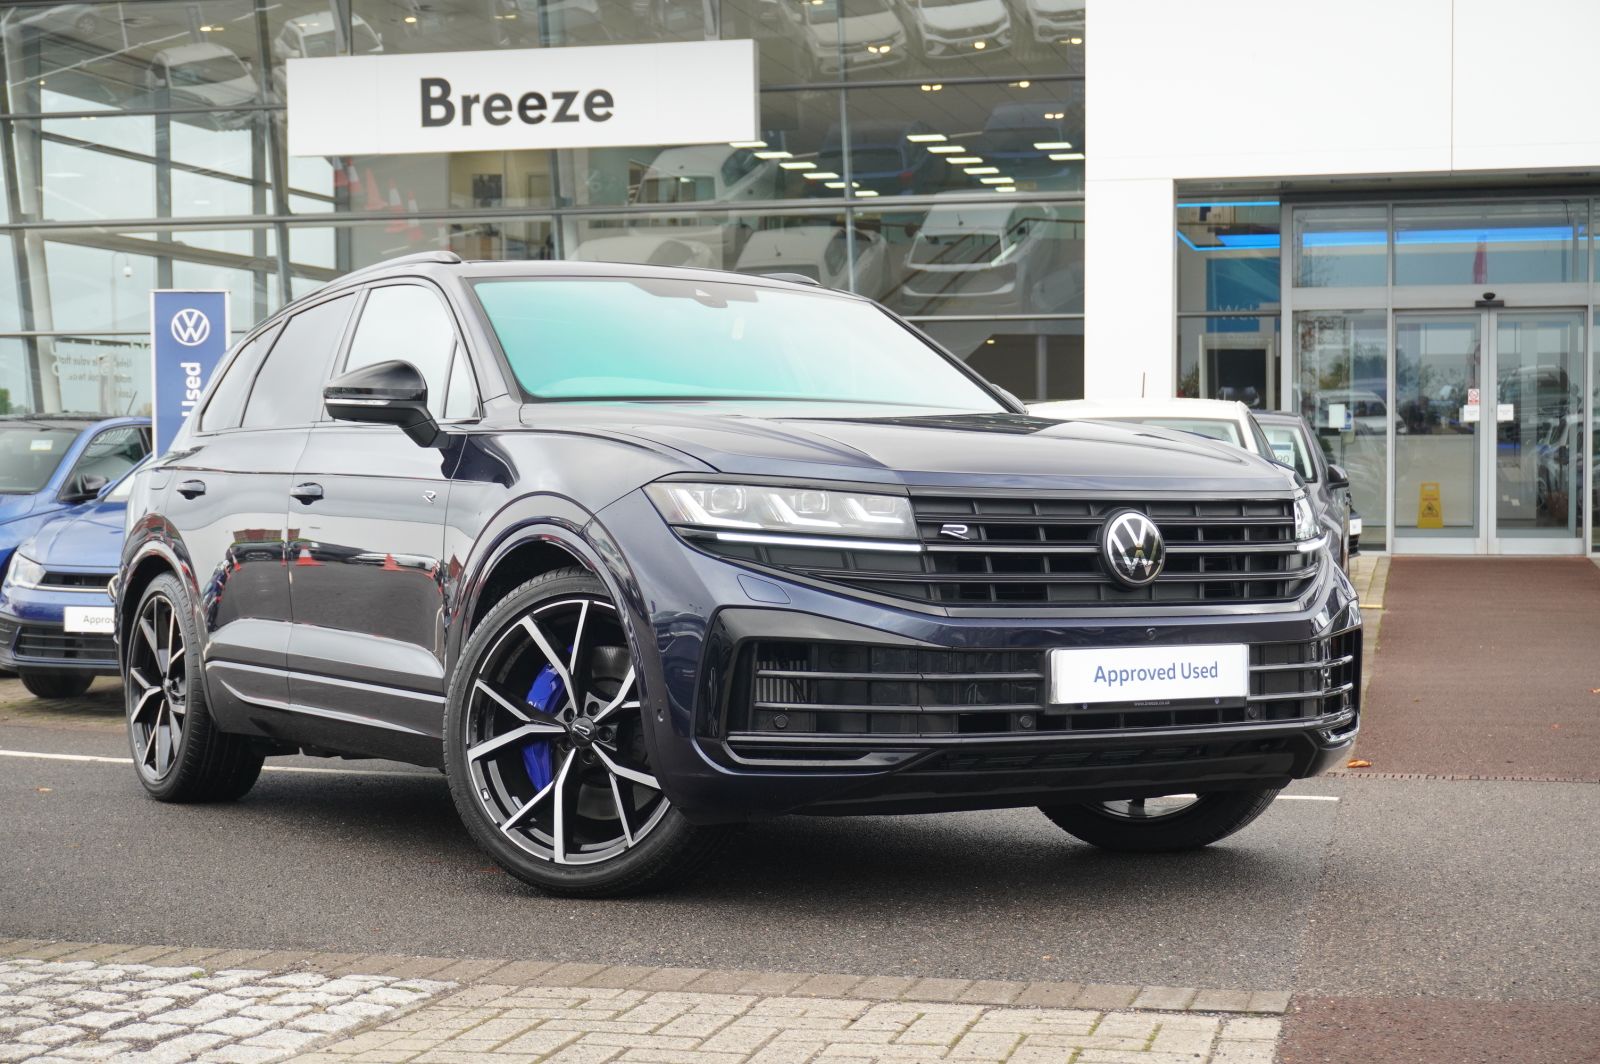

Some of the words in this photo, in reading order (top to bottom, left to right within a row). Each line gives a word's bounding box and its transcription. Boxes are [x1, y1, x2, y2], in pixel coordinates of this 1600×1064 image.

[420, 77, 614, 127] Breeze
[1094, 662, 1176, 687] Approved
[1180, 661, 1218, 680] Used
